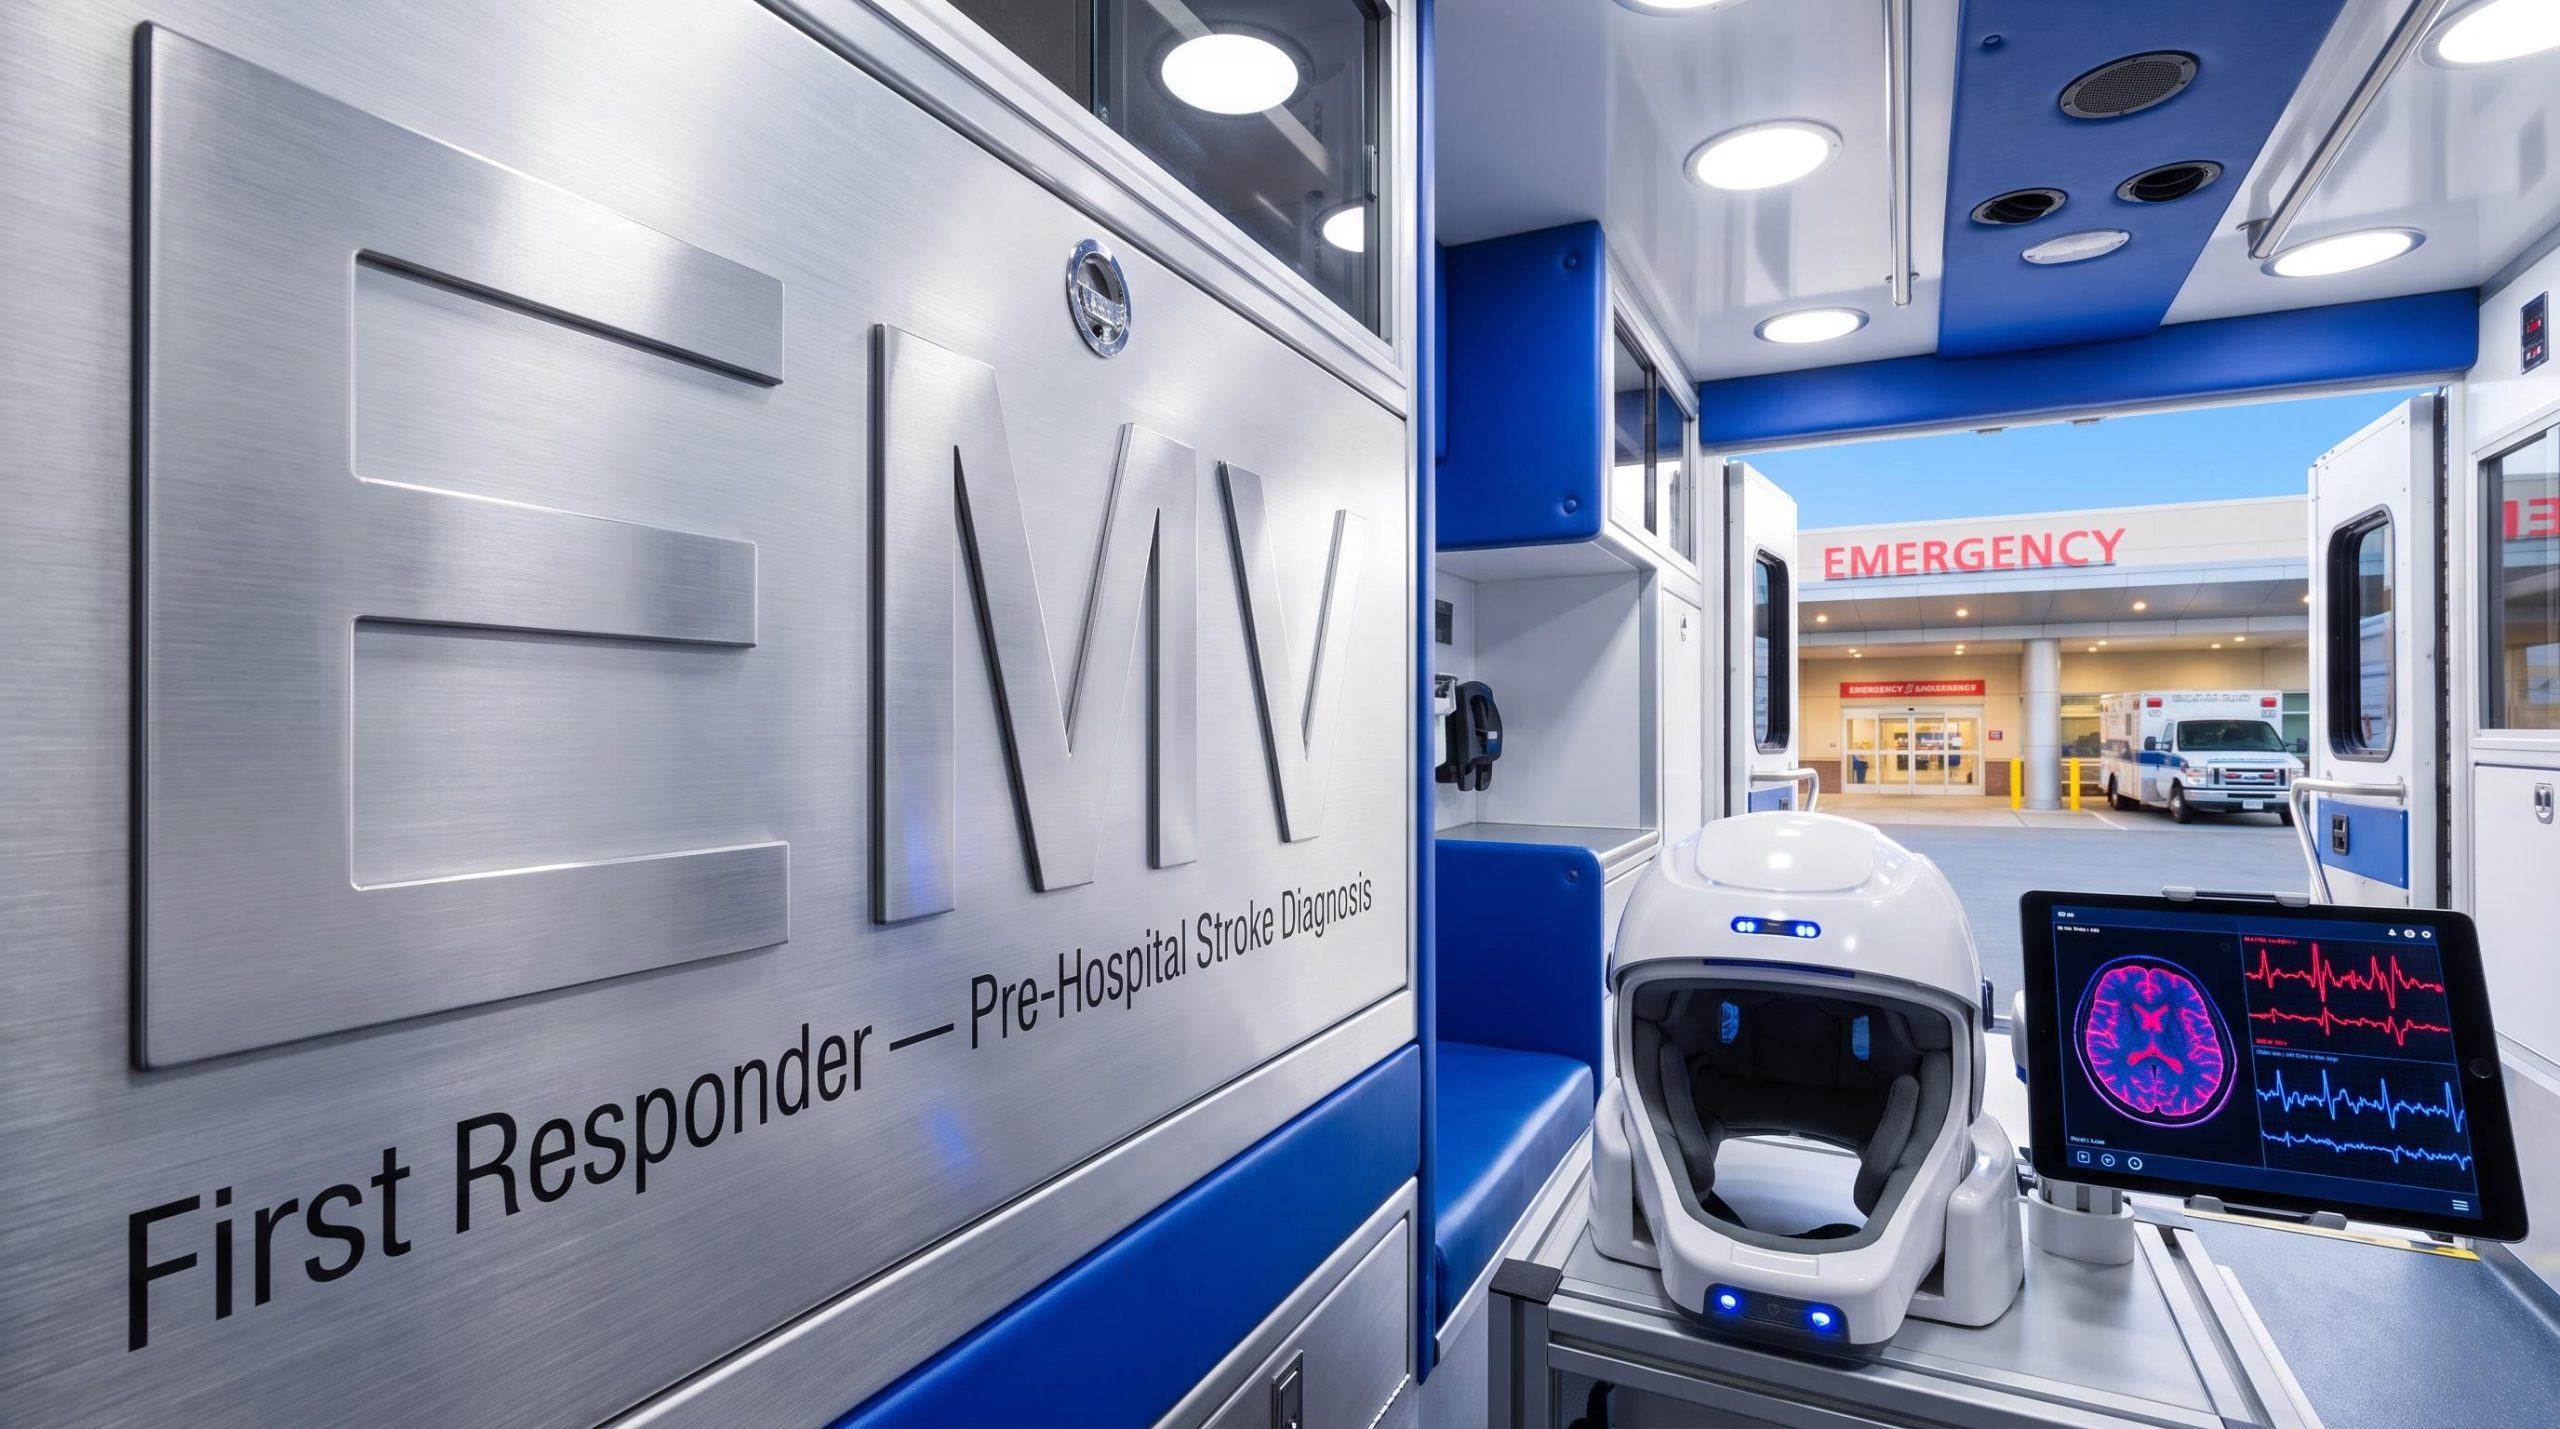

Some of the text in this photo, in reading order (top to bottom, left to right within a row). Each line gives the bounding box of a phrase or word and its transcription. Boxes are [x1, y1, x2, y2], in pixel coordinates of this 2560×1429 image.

[132, 20, 1367, 1074] EMV
[1824, 528, 2126, 579] EMERGENCY
[127, 1146, 412, 1353] First
[455, 1023, 873, 1235] Responder
[971, 919, 1187, 1050] Pre-Hospital
[1197, 899, 1274, 970] Stroke
[1282, 870, 1372, 940] Diagnosis
